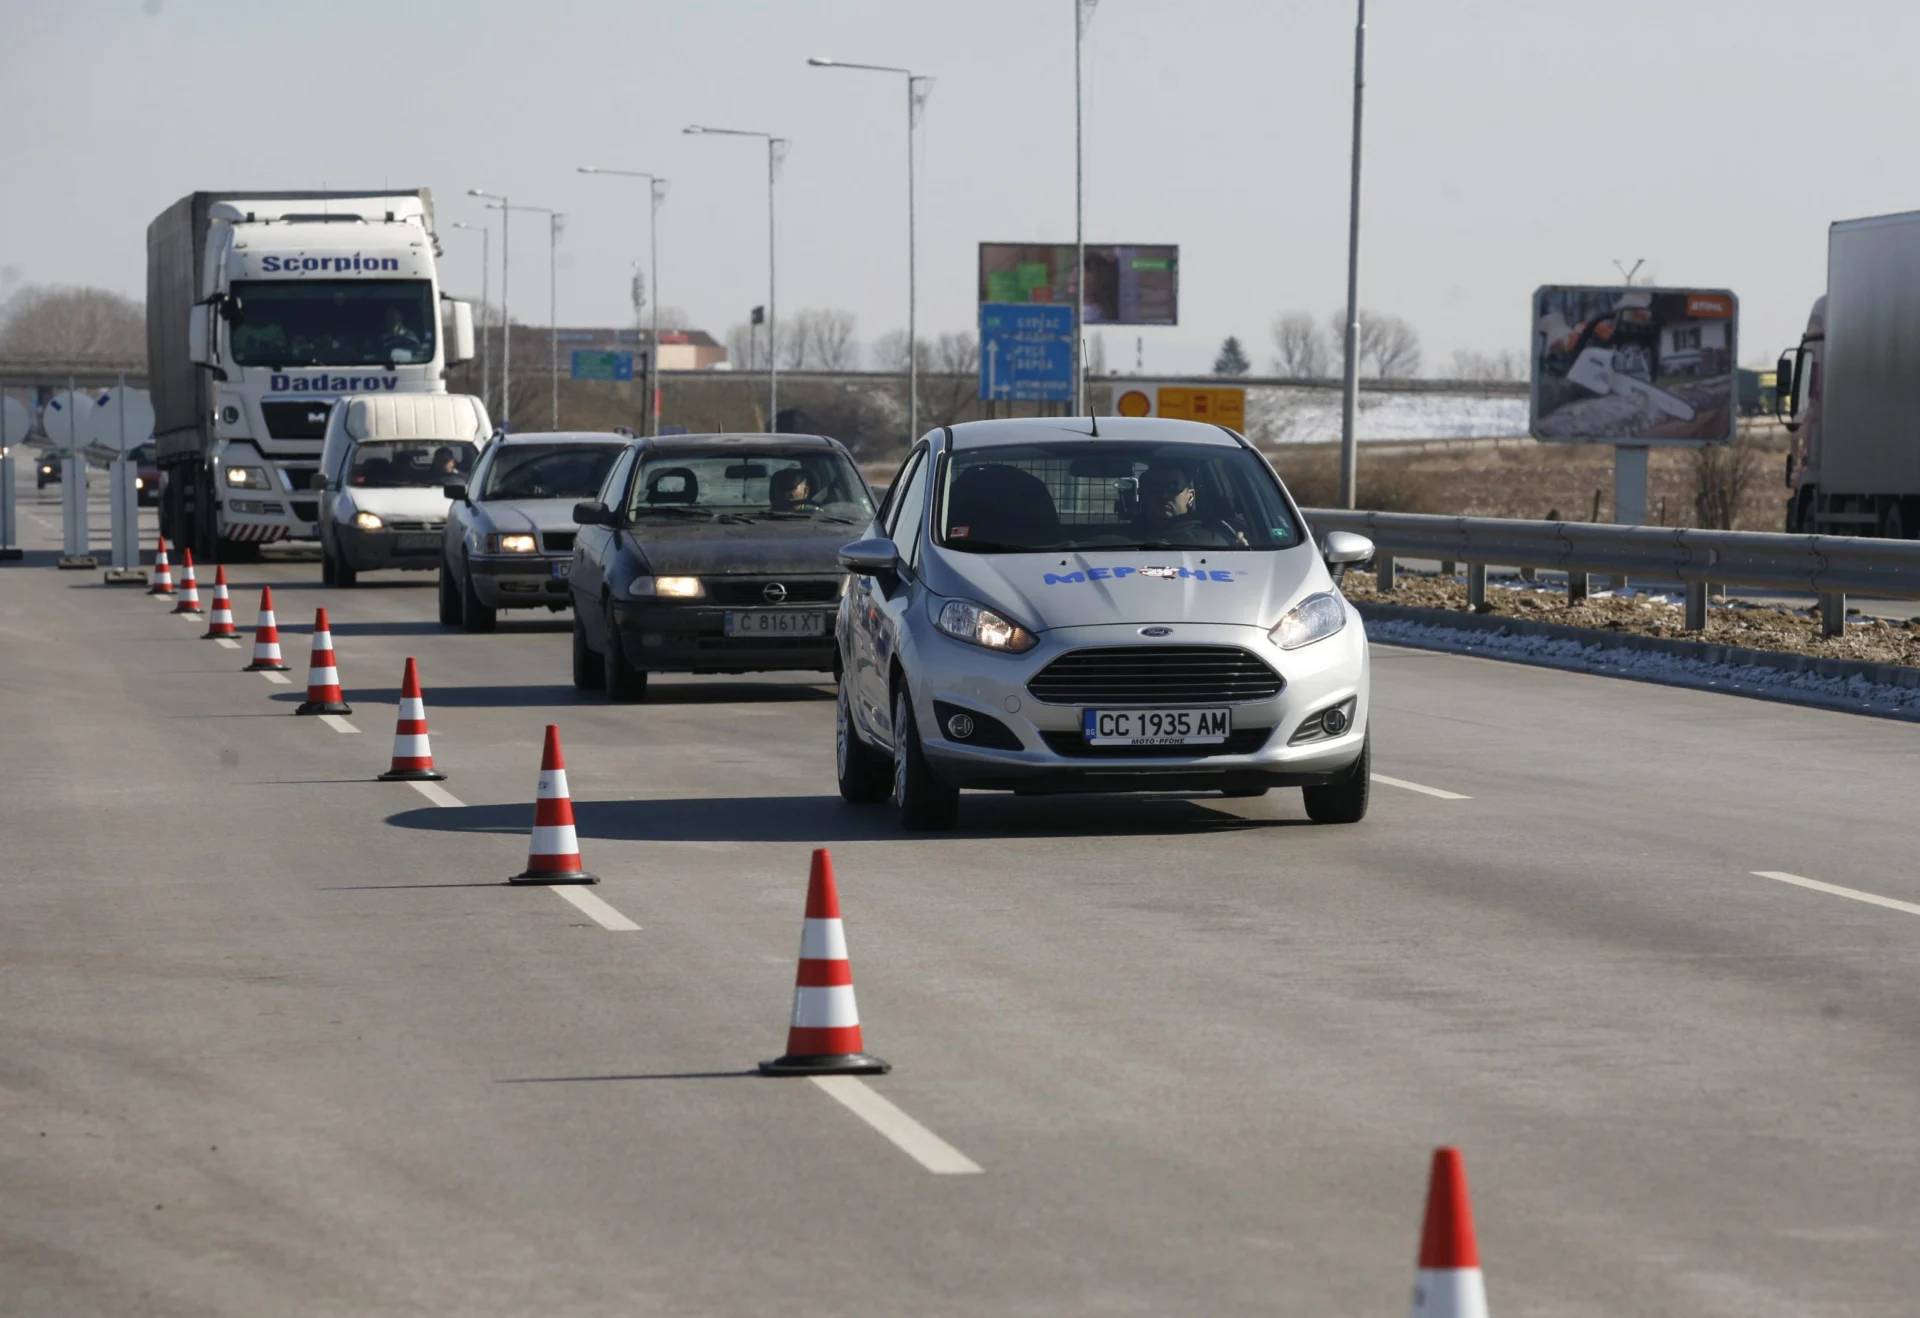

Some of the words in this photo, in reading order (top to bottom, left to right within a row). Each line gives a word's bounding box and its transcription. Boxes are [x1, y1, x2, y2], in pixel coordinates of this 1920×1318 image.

[261, 255, 399, 272] Scorpion
[270, 374, 398, 392] Dadarov
[760, 614, 796, 631] 8161
[801, 614, 822, 631] XT
[1085, 728, 1096, 736] BG
[1100, 713, 1130, 736] CC
[1138, 712, 1191, 736] 1935
[1196, 711, 1226, 735] AM
